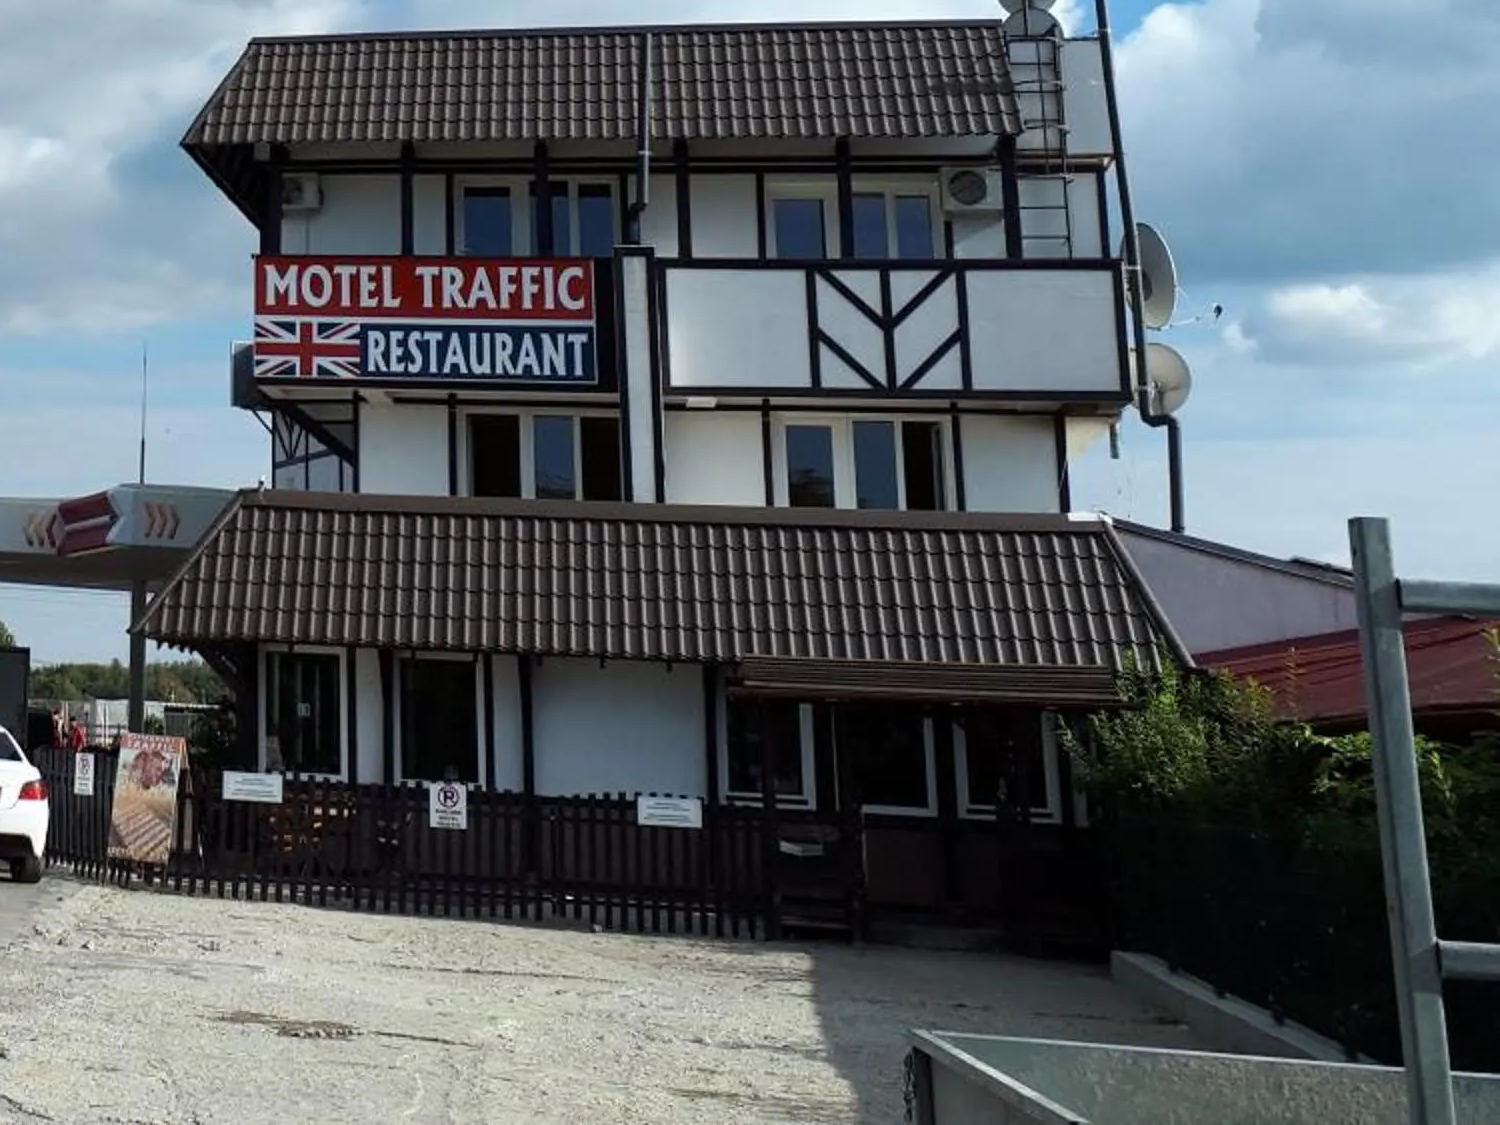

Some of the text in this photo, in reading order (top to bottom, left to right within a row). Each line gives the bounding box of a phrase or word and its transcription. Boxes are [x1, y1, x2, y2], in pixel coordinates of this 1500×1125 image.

[263, 263, 585, 311] MOTEL TRAFFIC
[366, 330, 589, 376] RESTAURANT
